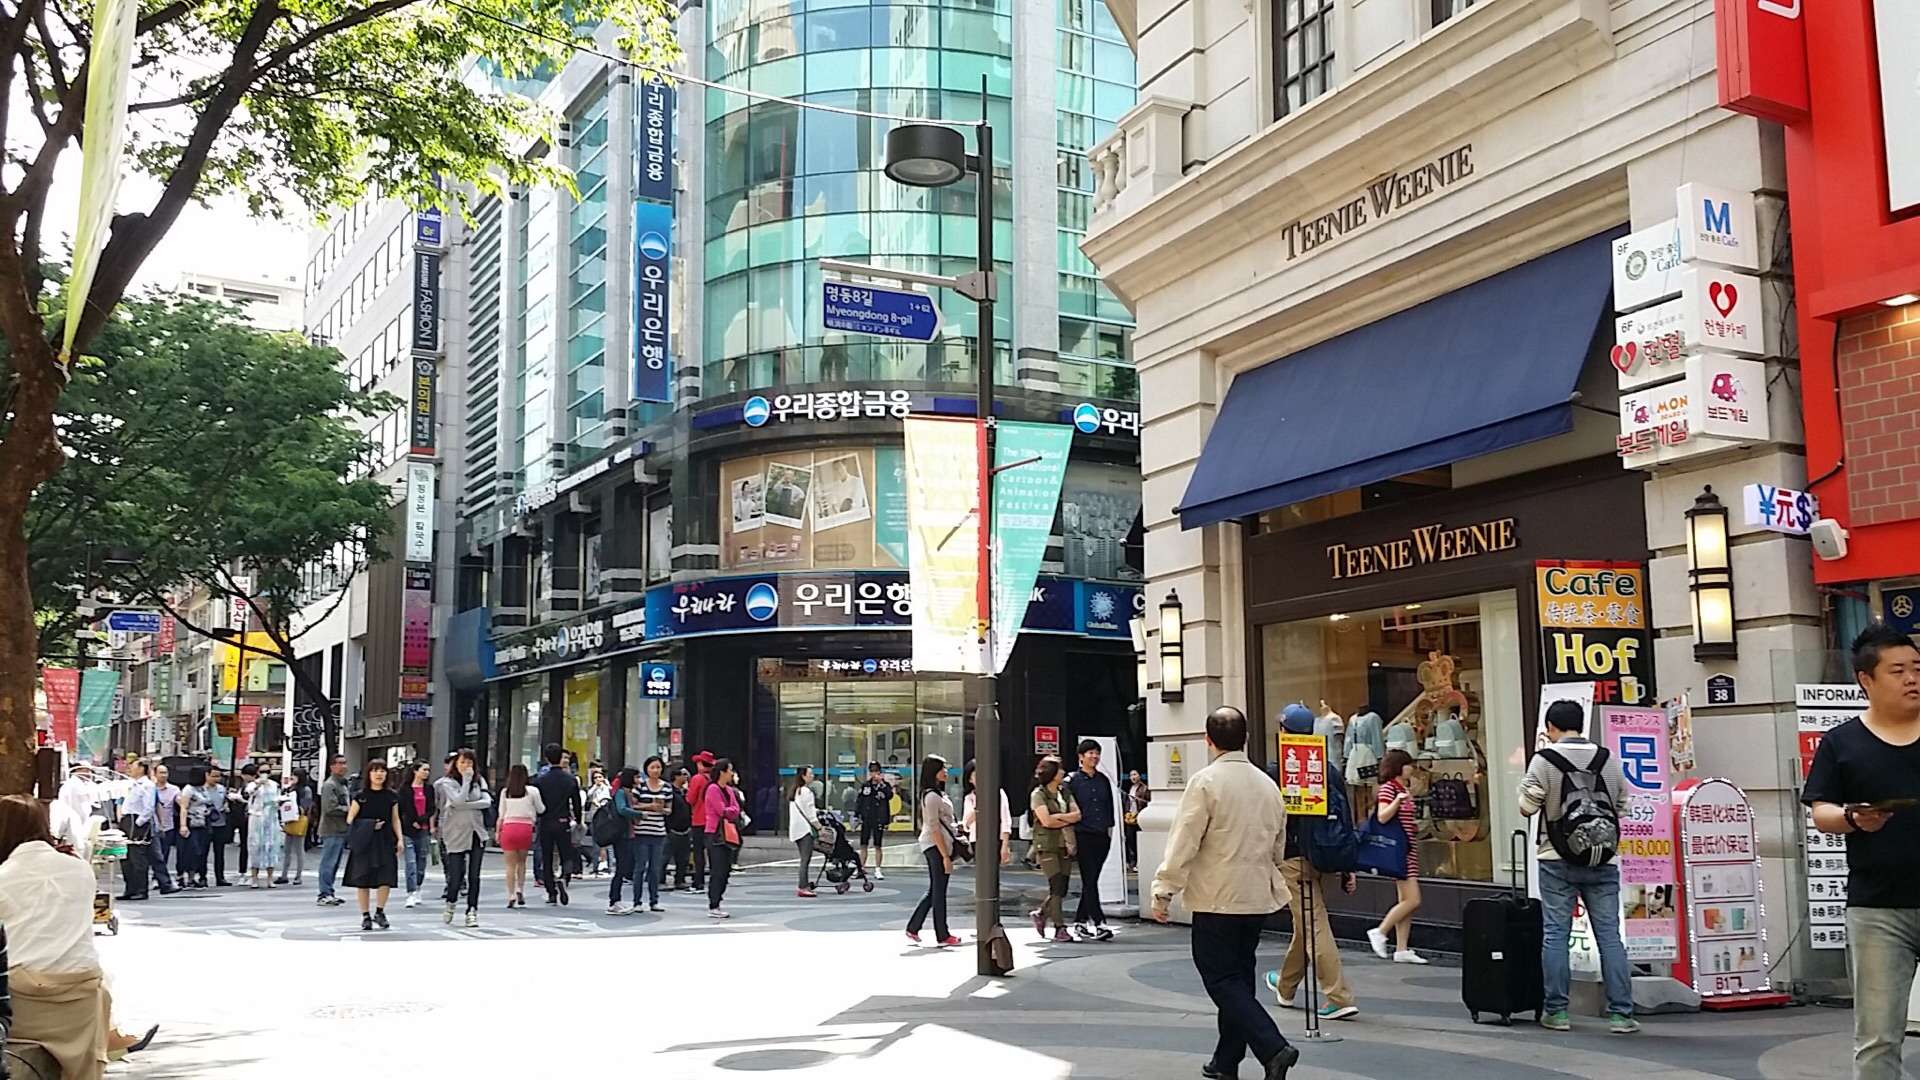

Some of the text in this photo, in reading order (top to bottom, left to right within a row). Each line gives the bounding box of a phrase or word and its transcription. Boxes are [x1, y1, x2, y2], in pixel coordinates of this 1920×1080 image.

[1281, 144, 1475, 261] TEENIE WEENIE
[1703, 198, 1732, 235] M
[825, 285, 873, 307] 명동8길
[418, 288, 433, 339] FASHION
[641, 265, 665, 370] 우리은행
[826, 304, 913, 326] Myeongdong 8-gil
[771, 389, 913, 422] 우리종합금융
[1707, 405, 1749, 423] 보드게임
[1616, 419, 1690, 457] 보드게임
[1327, 518, 1517, 579] TEENIE WEENIE
[1544, 567, 1637, 597] Cafe
[670, 592, 738, 624] 우리나라
[792, 582, 913, 616] 우리은행
[570, 620, 604, 653] 우리은행
[879, 659, 914, 673] 우리은
[1553, 632, 1640, 676] Hof
[1714, 689, 1729, 702] 38
[1619, 735, 1662, 790] 足
[1688, 803, 1748, 824] 韩国化妆品
[1691, 834, 1750, 856] 最低价保证
[1715, 977, 1730, 991] B1
